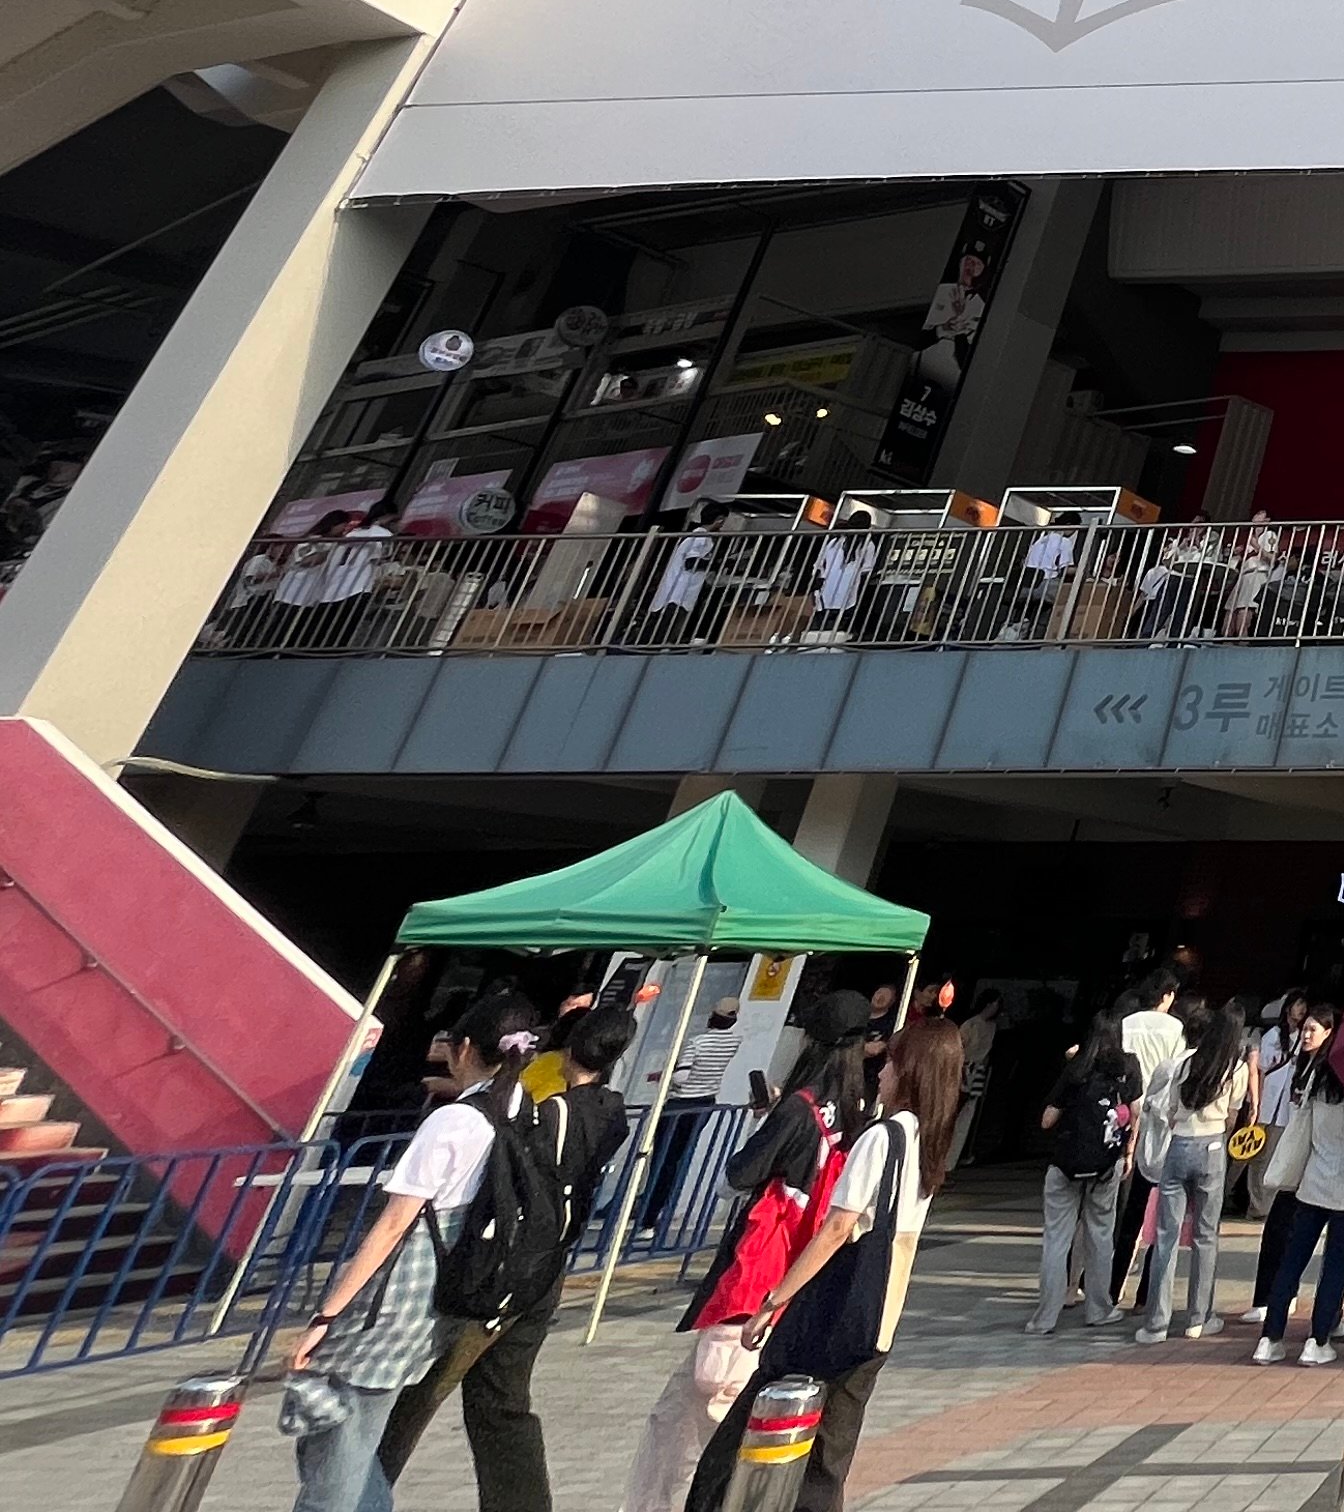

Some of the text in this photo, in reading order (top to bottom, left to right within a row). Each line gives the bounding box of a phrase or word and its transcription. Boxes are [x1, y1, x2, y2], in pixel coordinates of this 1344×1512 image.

[476, 493, 511, 515] 커피
[1173, 682, 1253, 737] 3루
[1254, 712, 1340, 743] 매표소
